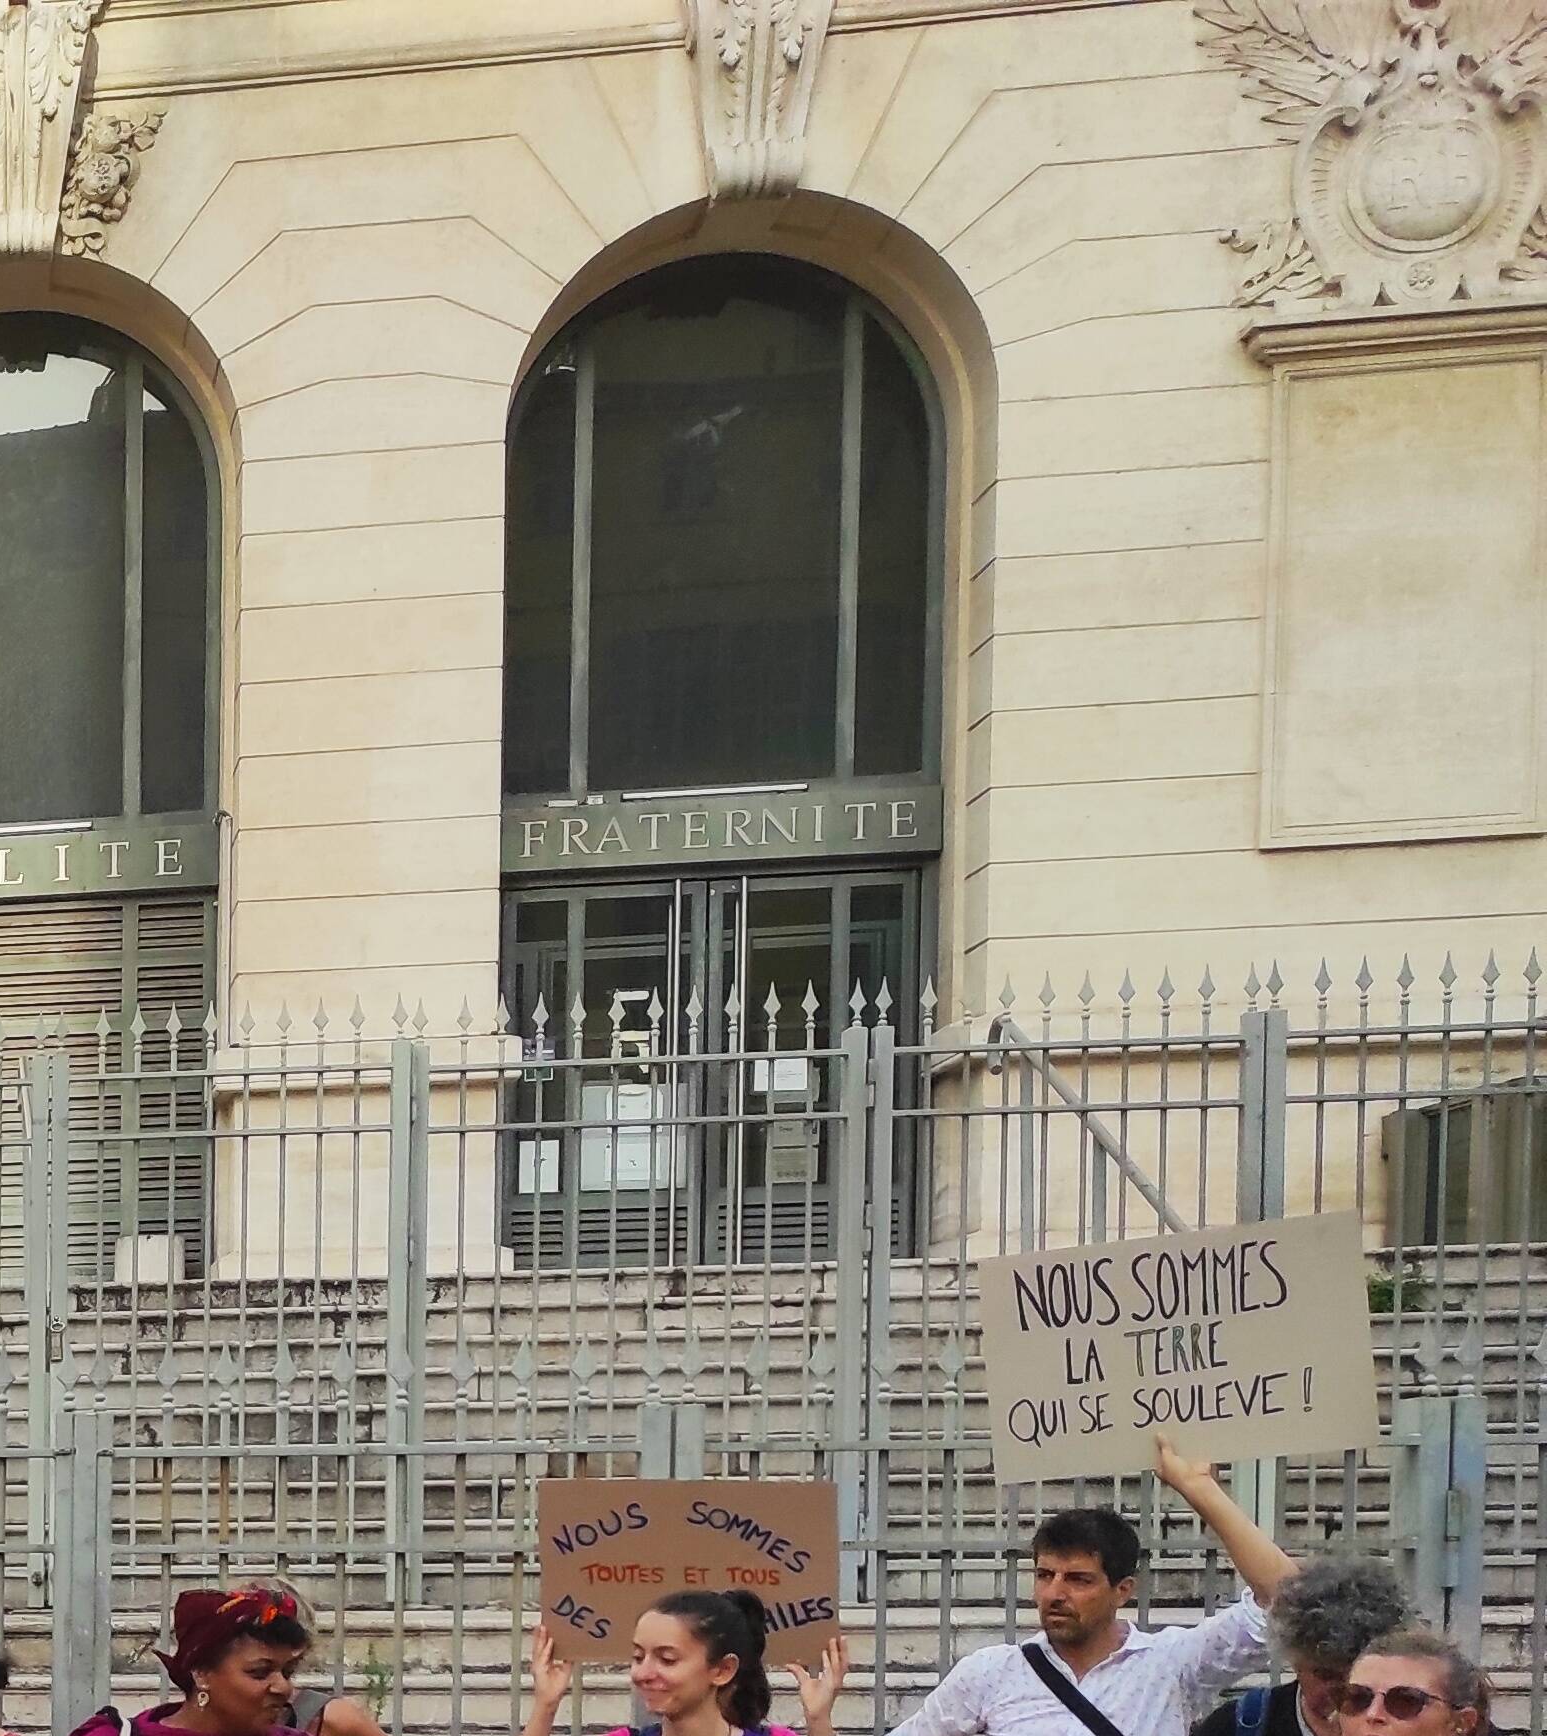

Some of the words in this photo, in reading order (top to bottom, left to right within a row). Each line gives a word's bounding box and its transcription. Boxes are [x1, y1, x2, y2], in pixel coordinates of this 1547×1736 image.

[518, 800, 919, 858] FRATERNITE
[1013, 1257, 1121, 1332] NOUS
[1130, 1240, 1288, 1322] SOMMES
[1065, 1337, 1105, 1385] LA
[1123, 1320, 1228, 1378] TERRE
[1008, 1398, 1068, 1448] QUI
[1080, 1392, 1114, 1434] SE
[1132, 1372, 1289, 1429] SOULEVE
[552, 1502, 649, 1555] NOUS
[686, 1500, 811, 1574] SOMMES
[580, 1563, 664, 1585] TOUTES
[684, 1566, 710, 1584] ET
[726, 1566, 781, 1585] TOUS
[550, 1594, 612, 1639] DES
